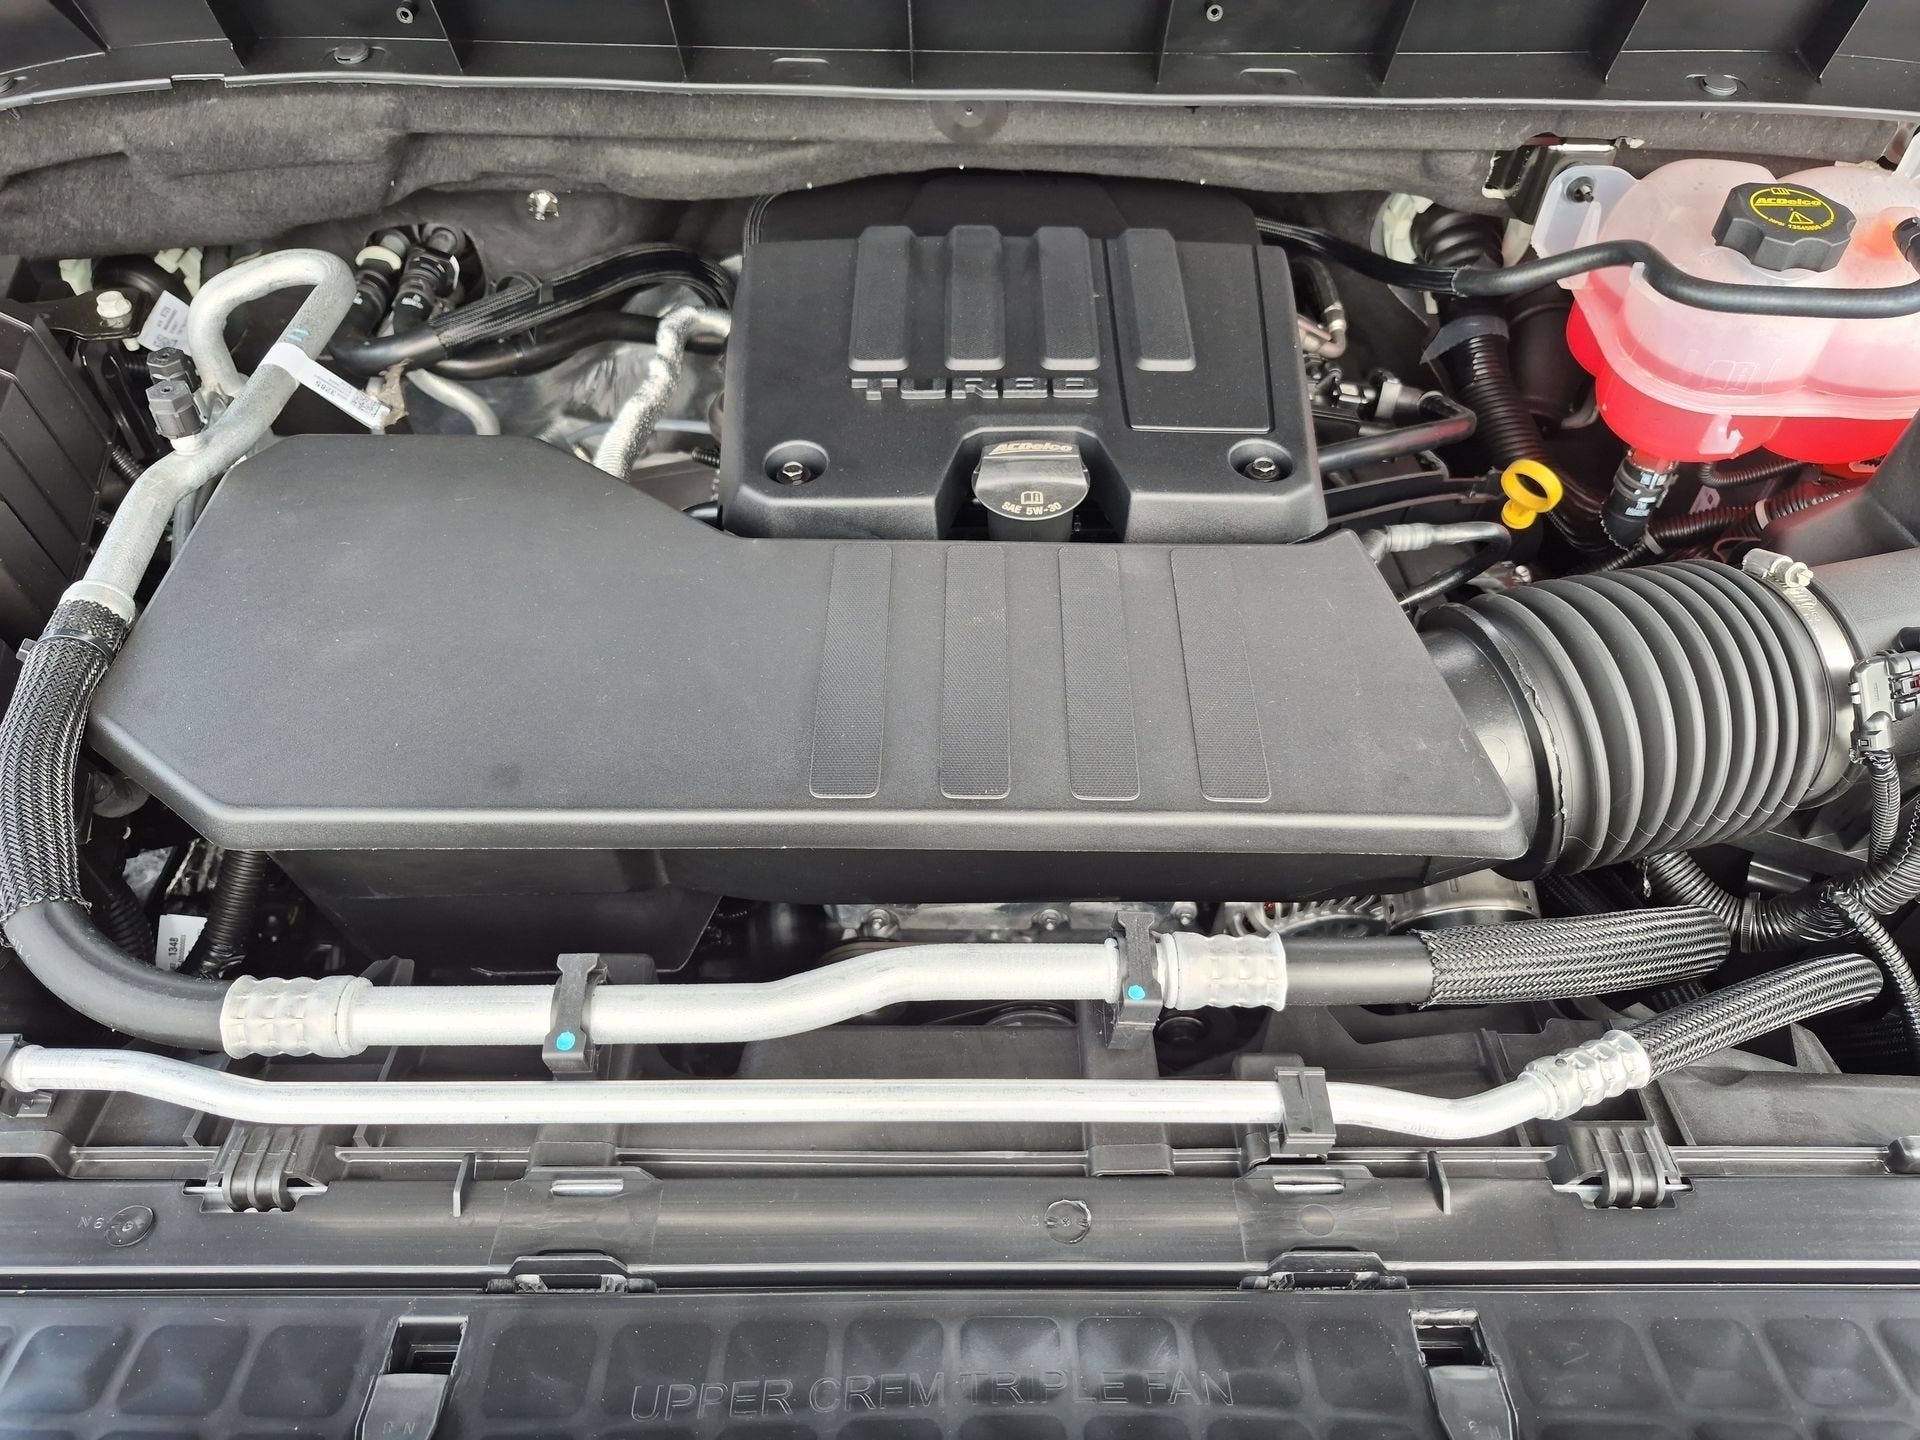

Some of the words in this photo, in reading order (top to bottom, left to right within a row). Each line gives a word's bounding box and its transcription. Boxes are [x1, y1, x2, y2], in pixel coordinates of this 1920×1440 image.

[1755, 197, 1822, 207] ACDelco
[851, 377, 1099, 401] TURBO
[988, 441, 1073, 456] ACDelco
[1001, 501, 1022, 514] SAE
[1025, 501, 1063, 516] 5W-30
[168, 937, 178, 956] 1348
[631, 1378, 793, 1423] UPPER
[809, 1371, 945, 1413] CRFM
[959, 1369, 1128, 1405] TRIPLE
[1143, 1369, 1234, 1407] FAN
